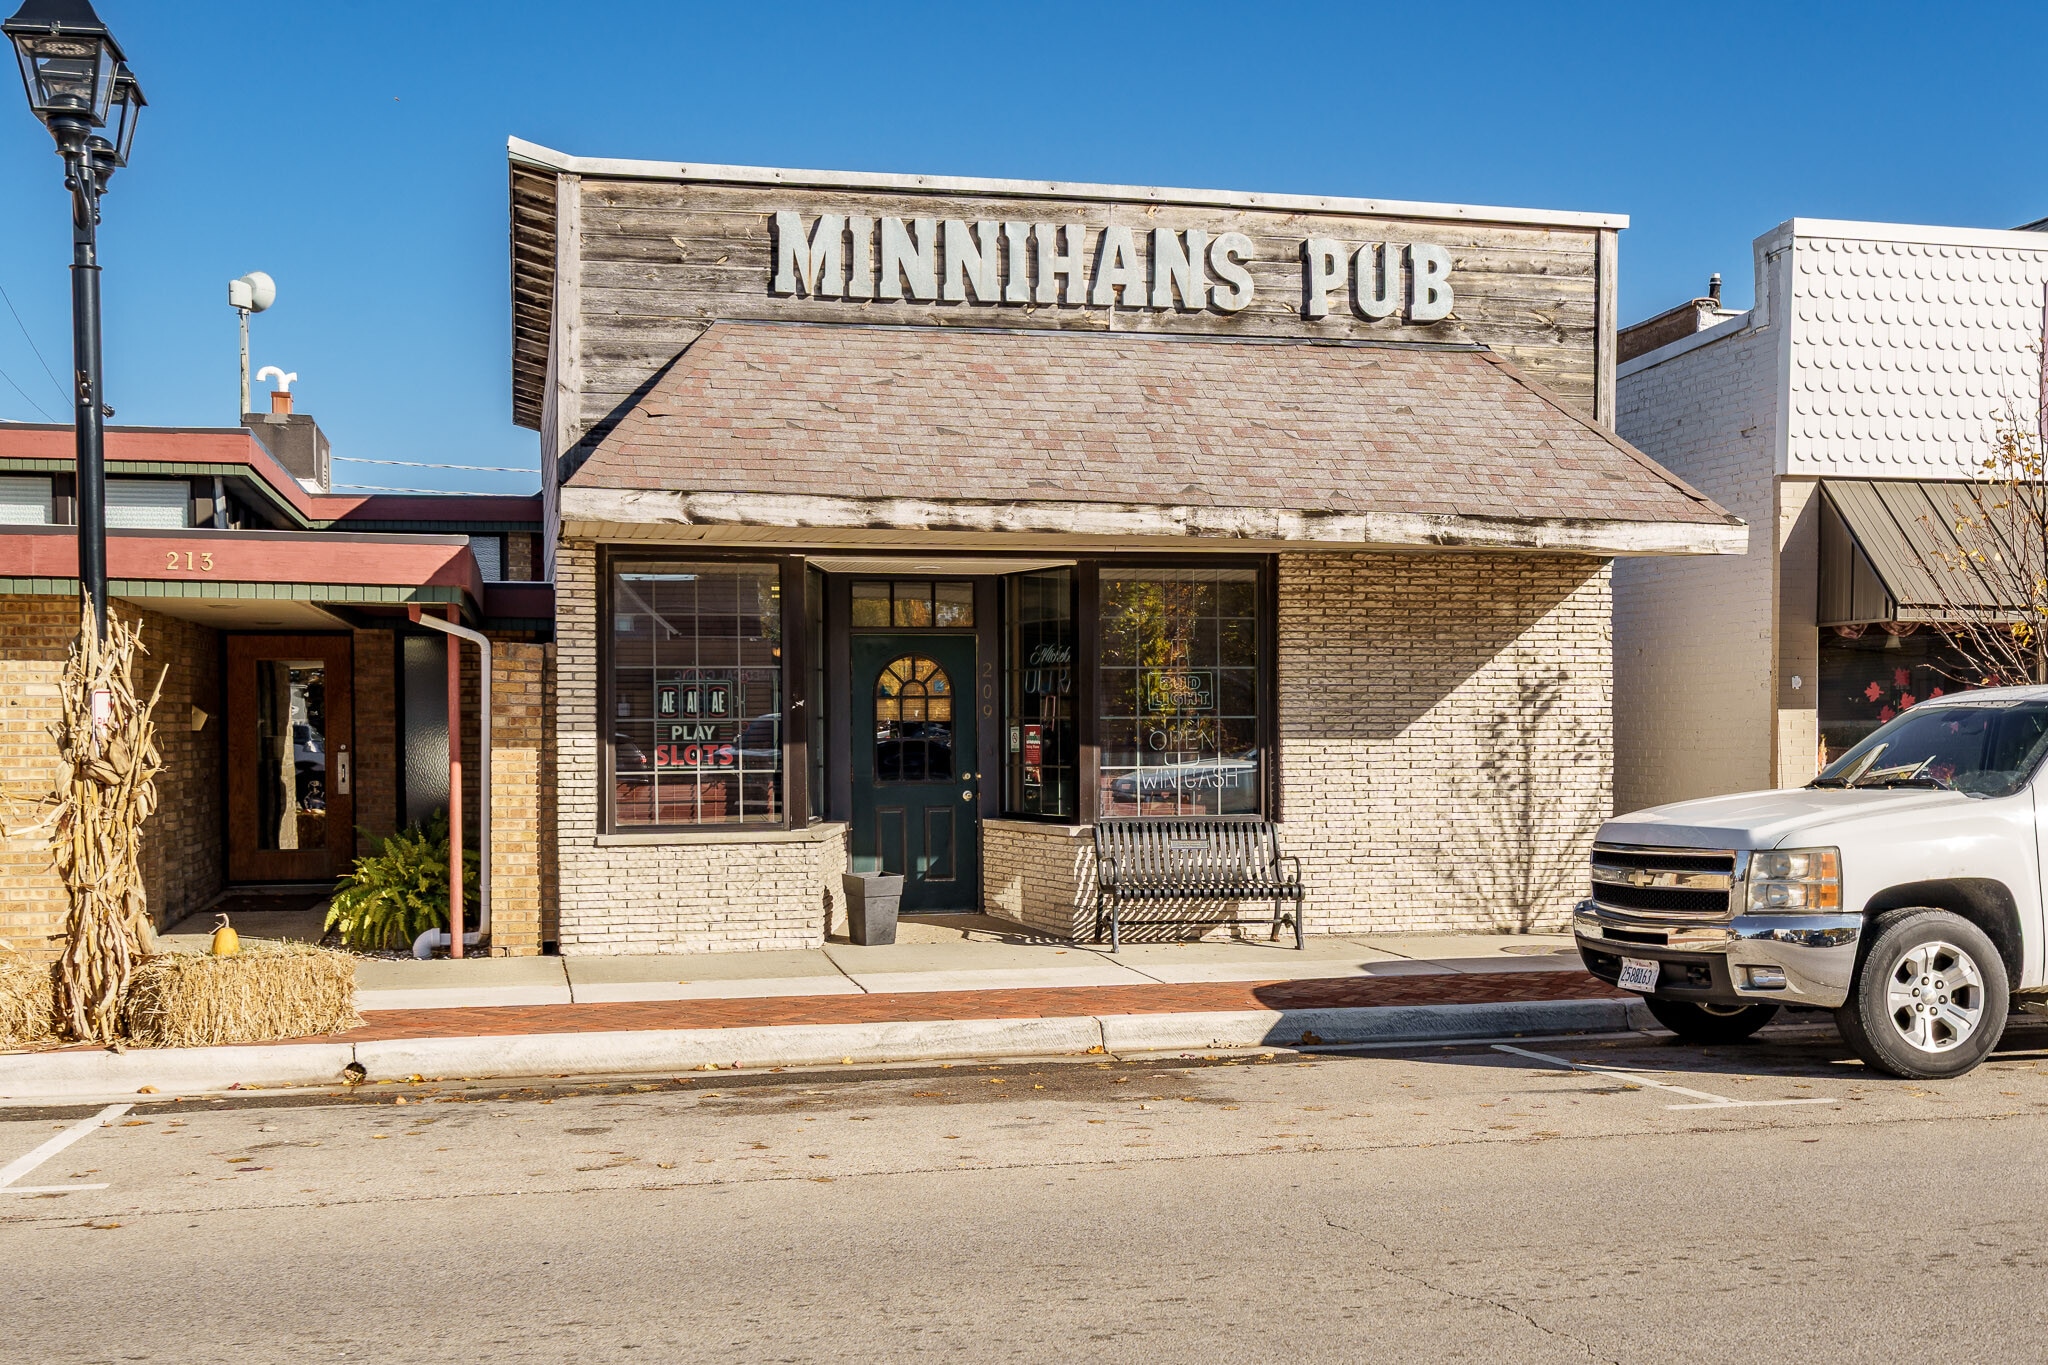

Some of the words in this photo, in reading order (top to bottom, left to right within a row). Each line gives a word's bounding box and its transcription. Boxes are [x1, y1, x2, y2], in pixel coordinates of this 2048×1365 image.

[772, 209, 1254, 313] MINNIHANS
[1303, 237, 1454, 322] PUB
[166, 551, 214, 572] 213
[982, 662, 993, 720] 209
[1159, 675, 1201, 690] BUD
[661, 691, 675, 713] AE
[711, 691, 725, 713] AE
[1151, 691, 1209, 706] LIGHT
[671, 725, 716, 741] PLAY
[1149, 729, 1216, 751] OPEN
[656, 743, 734, 766] SLOTS
[1139, 766, 1177, 789] WIN
[1184, 766, 1239, 789] CASH
